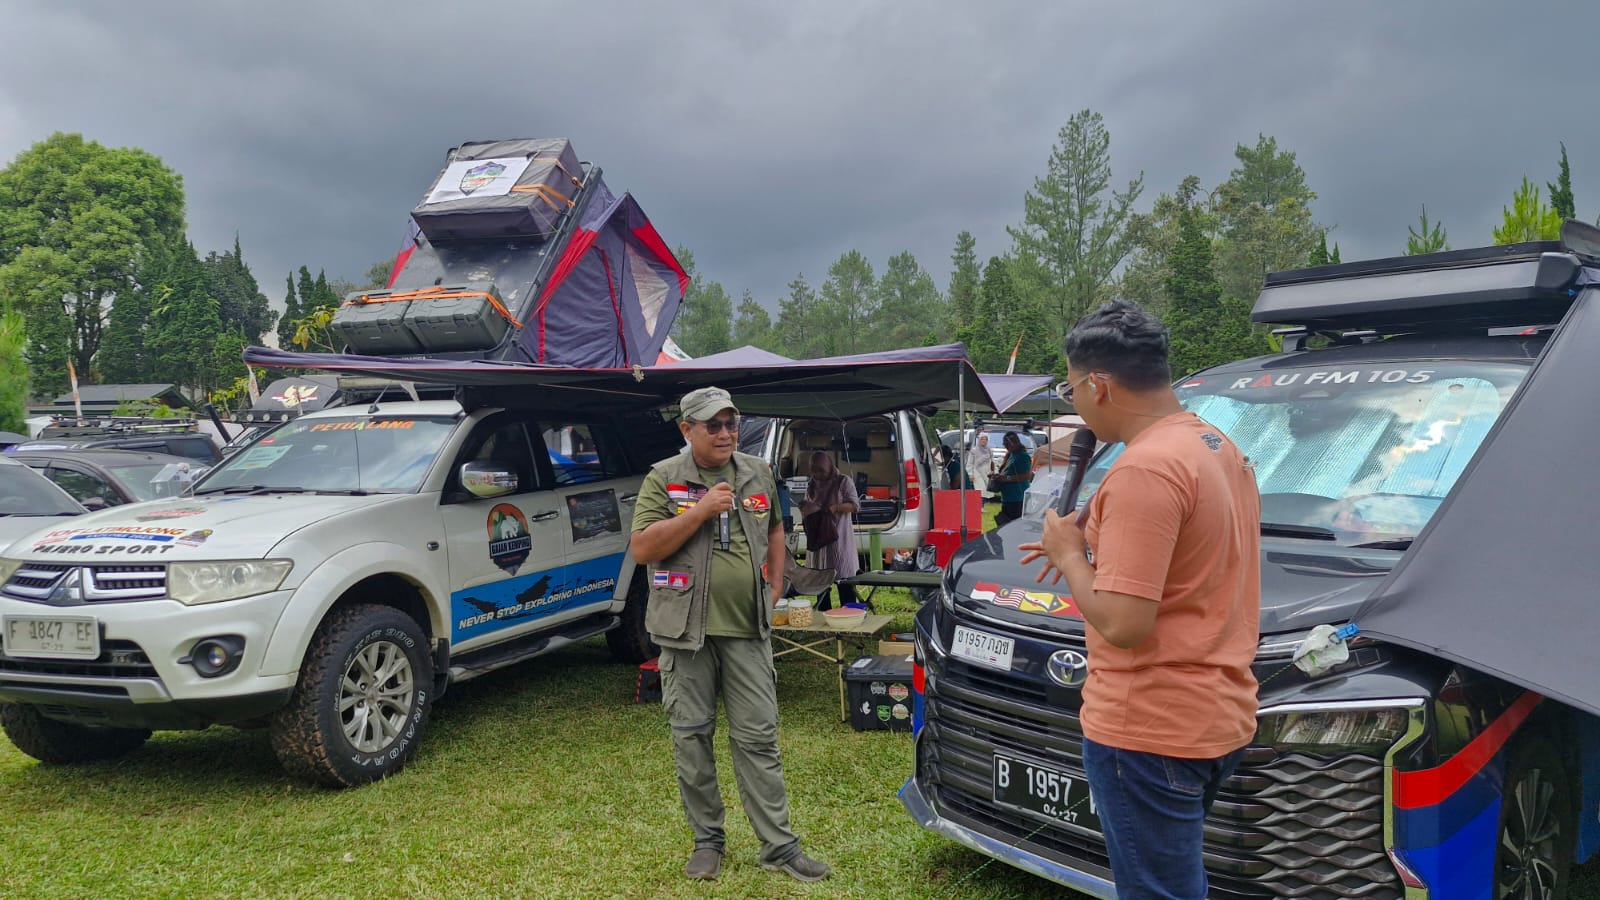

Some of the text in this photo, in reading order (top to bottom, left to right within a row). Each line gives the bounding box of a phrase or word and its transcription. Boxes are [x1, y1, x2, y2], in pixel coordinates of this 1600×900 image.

[1230, 369, 1436, 390] RAU FM 105
[310, 420, 416, 433] PETUALANG
[94, 544, 176, 555] SPORT
[458, 578, 615, 630] NEVER STOP EXPLORING INDONESIA
[10, 620, 92, 641] F 1847 EF
[965, 631, 988, 649] 1957
[998, 759, 1010, 788] B
[1026, 766, 1072, 807] 1957
